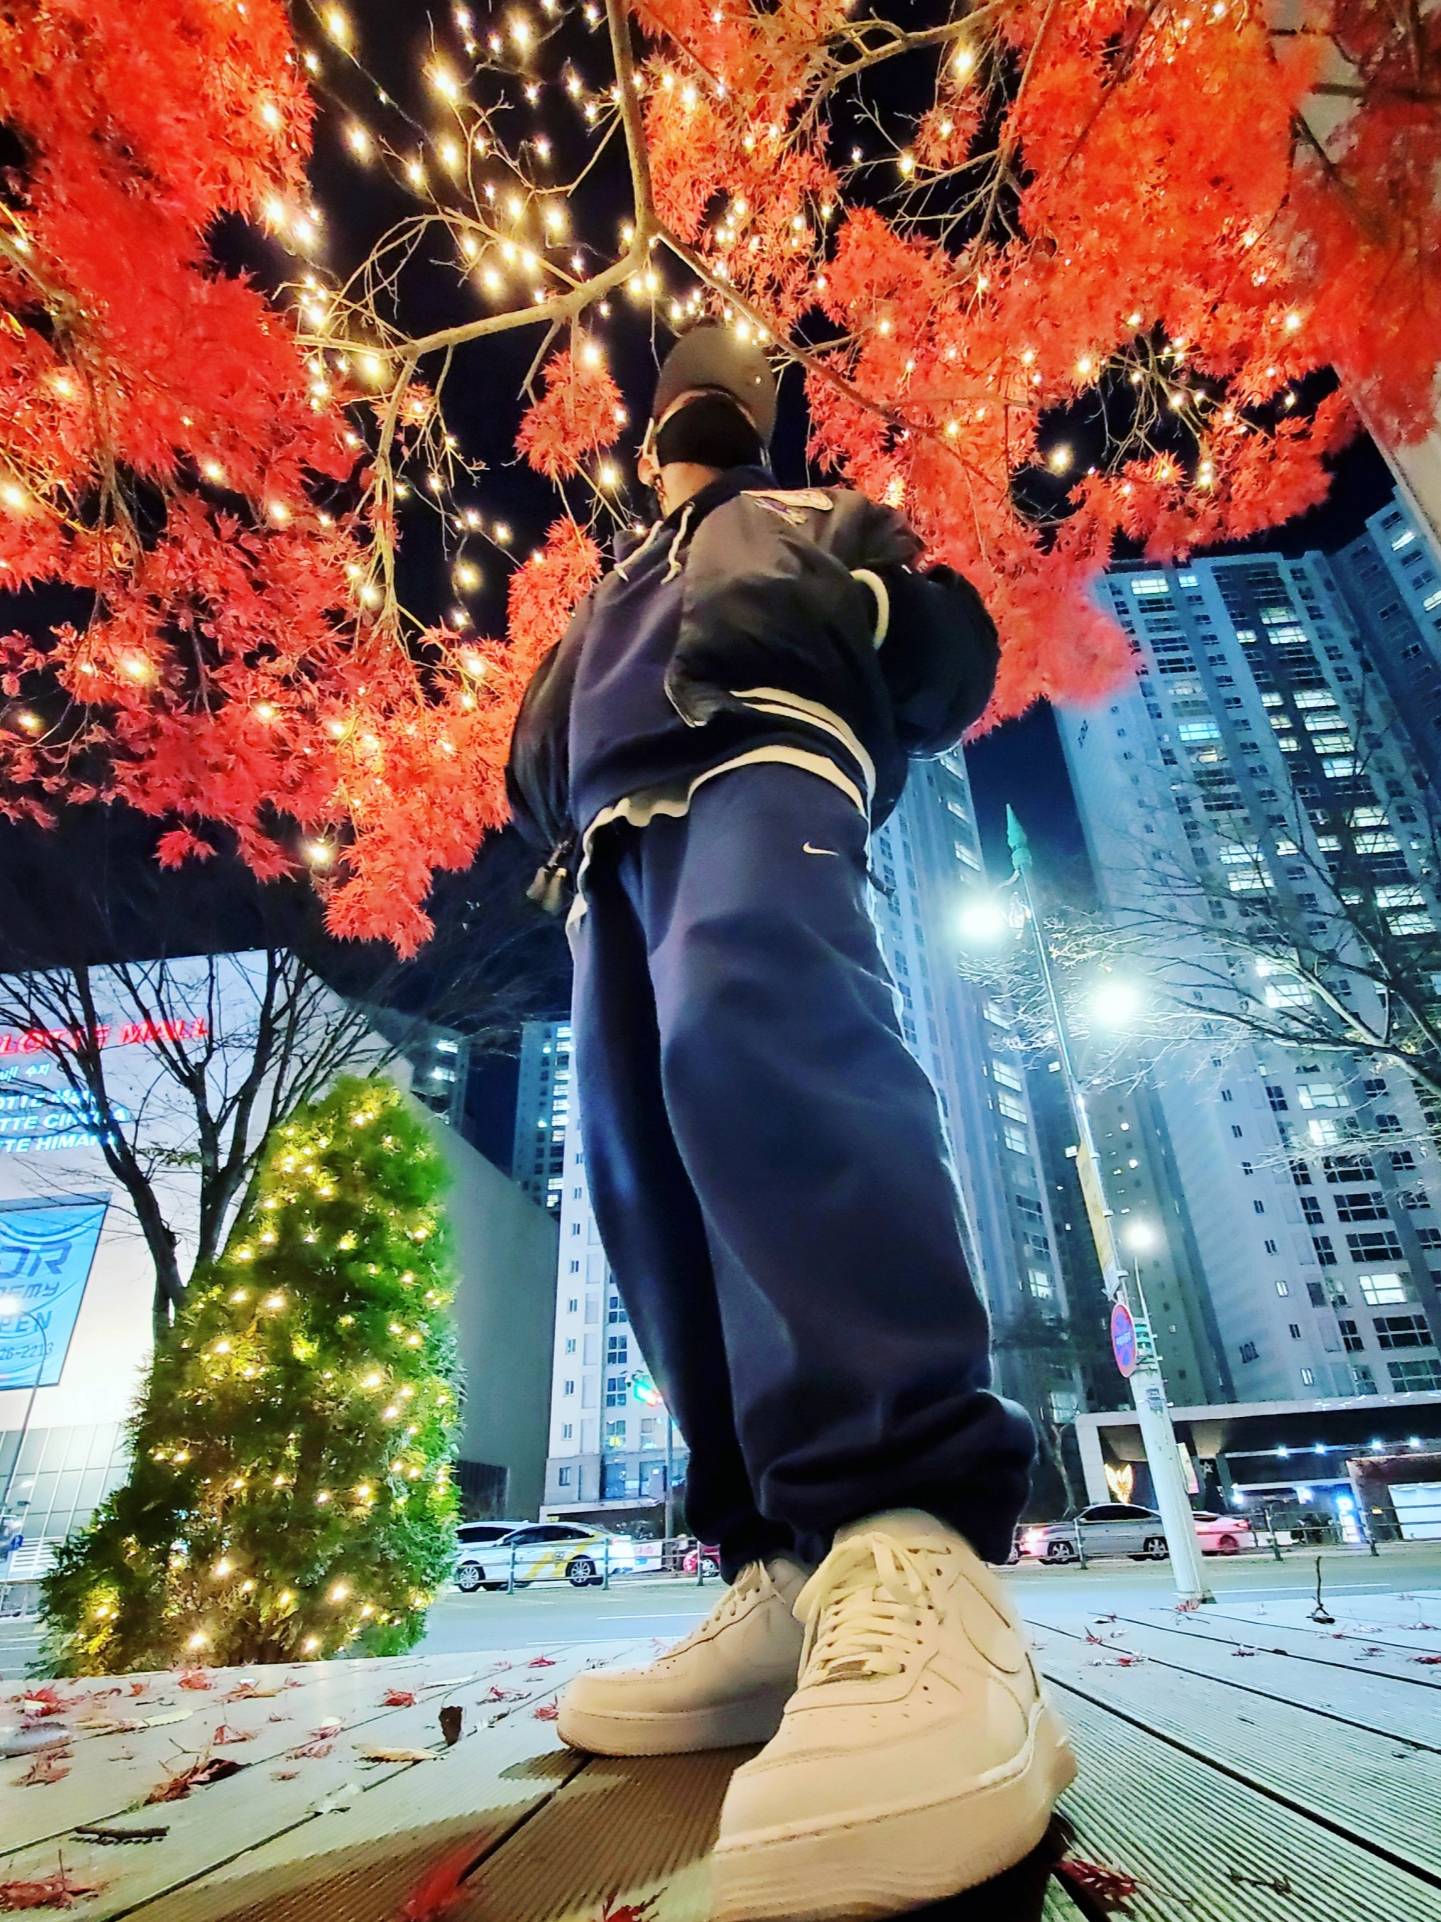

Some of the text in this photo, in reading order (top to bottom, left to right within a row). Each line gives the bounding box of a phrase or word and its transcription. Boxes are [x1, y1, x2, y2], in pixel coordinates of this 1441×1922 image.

[120, 1017, 209, 1043] MALL
[43, 1107, 127, 1130] CINA
[1238, 1340, 1260, 1364] 101
